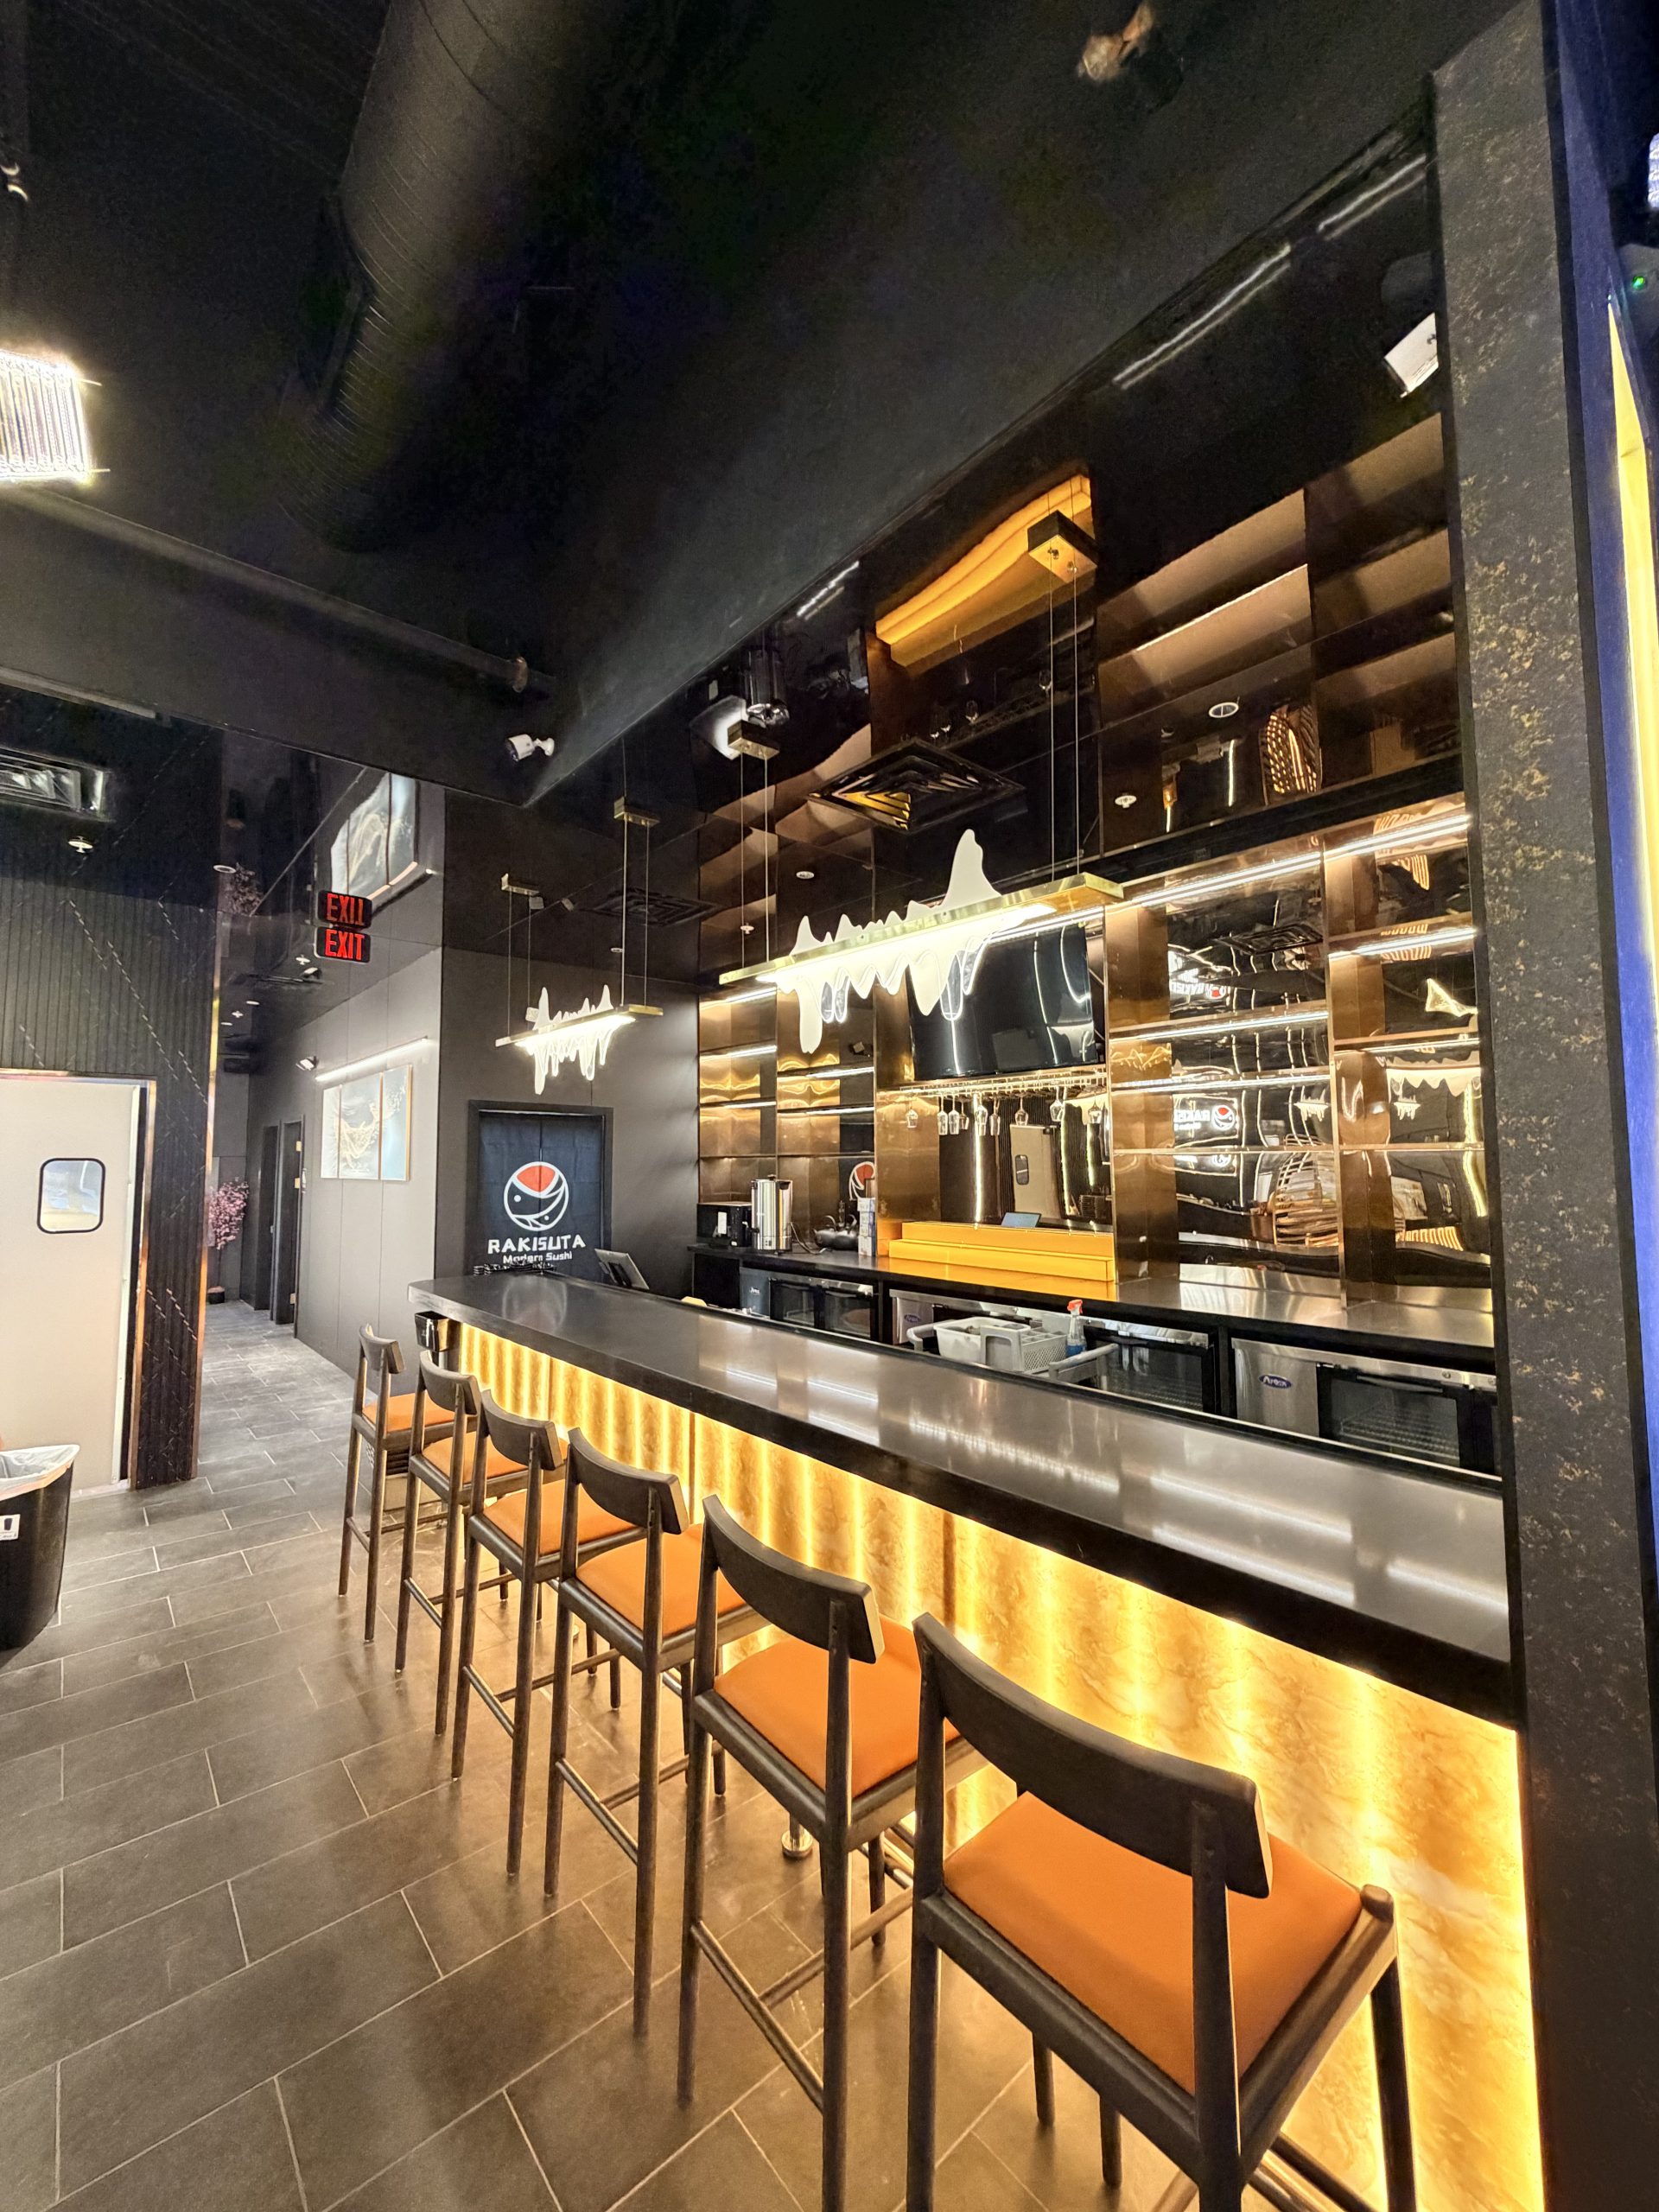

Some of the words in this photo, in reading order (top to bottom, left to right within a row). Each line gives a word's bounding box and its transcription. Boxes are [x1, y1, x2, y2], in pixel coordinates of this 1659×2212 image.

[325, 928, 365, 961] EXIT
[487, 1234, 586, 1255] RAKISUTA
[503, 1254, 543, 1264] Modern
[545, 1251, 573, 1261] Sushi
